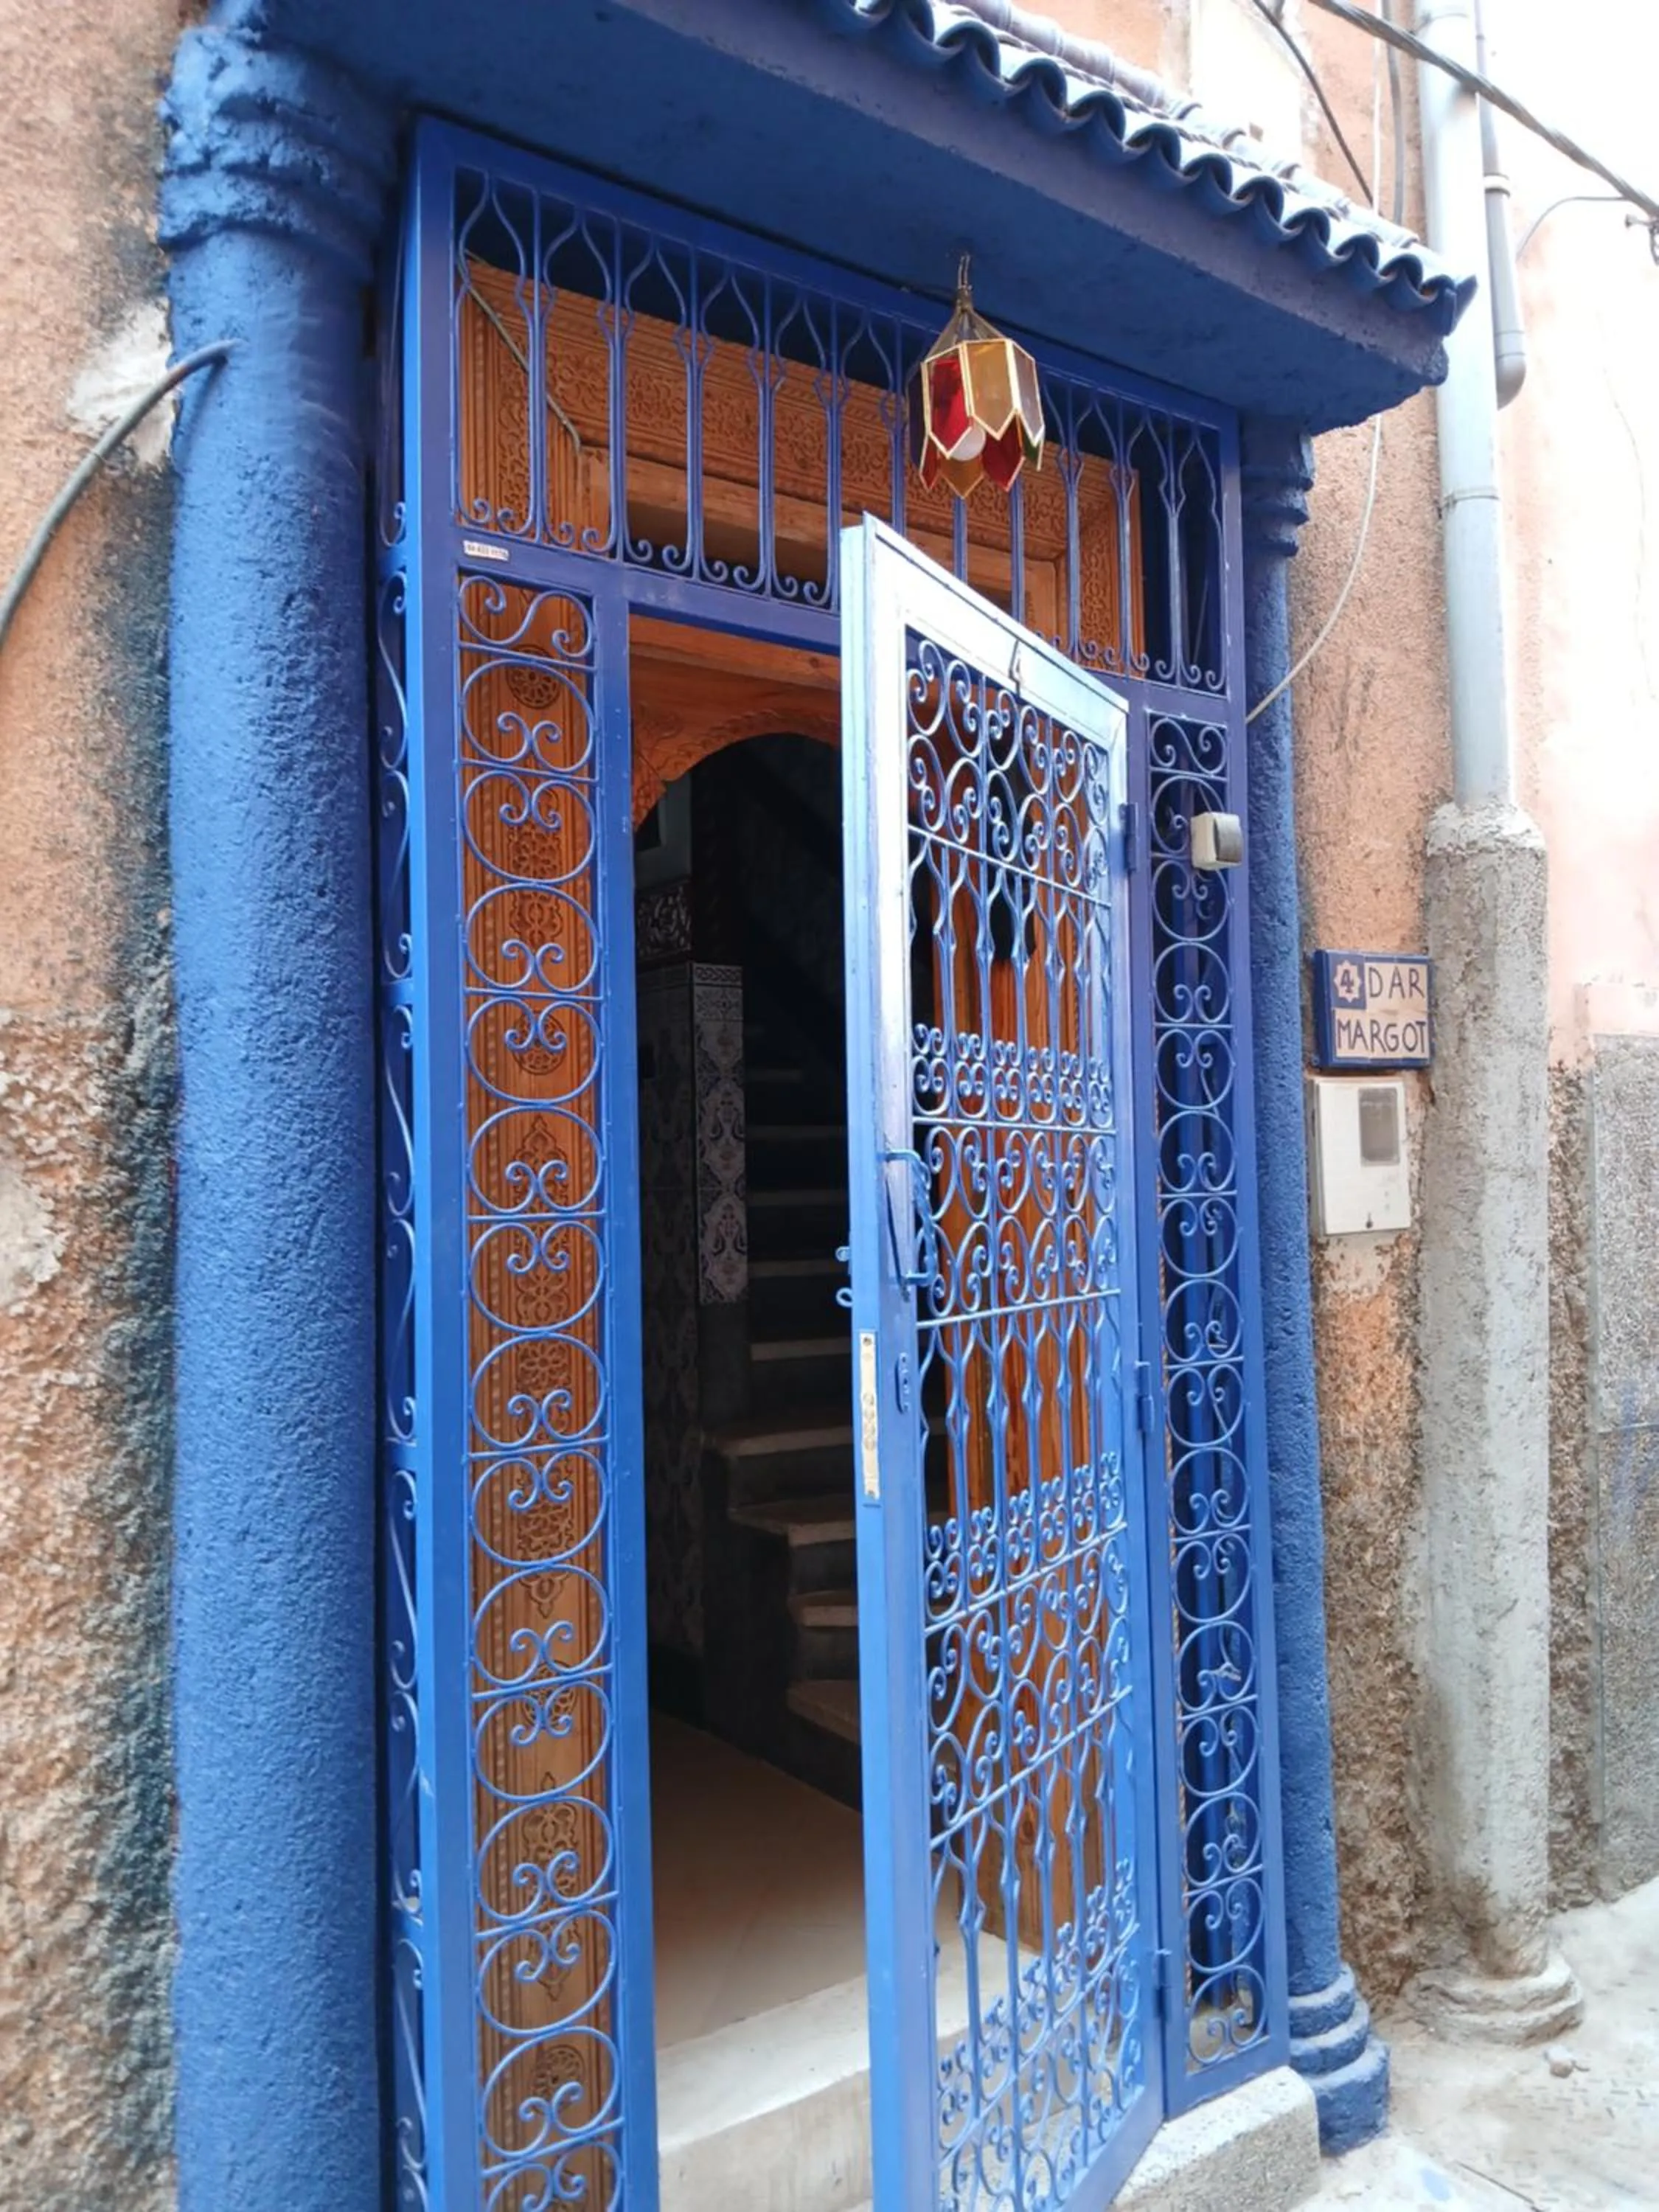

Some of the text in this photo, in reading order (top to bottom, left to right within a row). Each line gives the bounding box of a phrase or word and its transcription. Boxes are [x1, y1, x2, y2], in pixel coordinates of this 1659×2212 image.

[1340, 969, 1354, 993] 4
[1368, 966, 1425, 999] DAR
[1337, 1018, 1426, 1053] MARGOT
